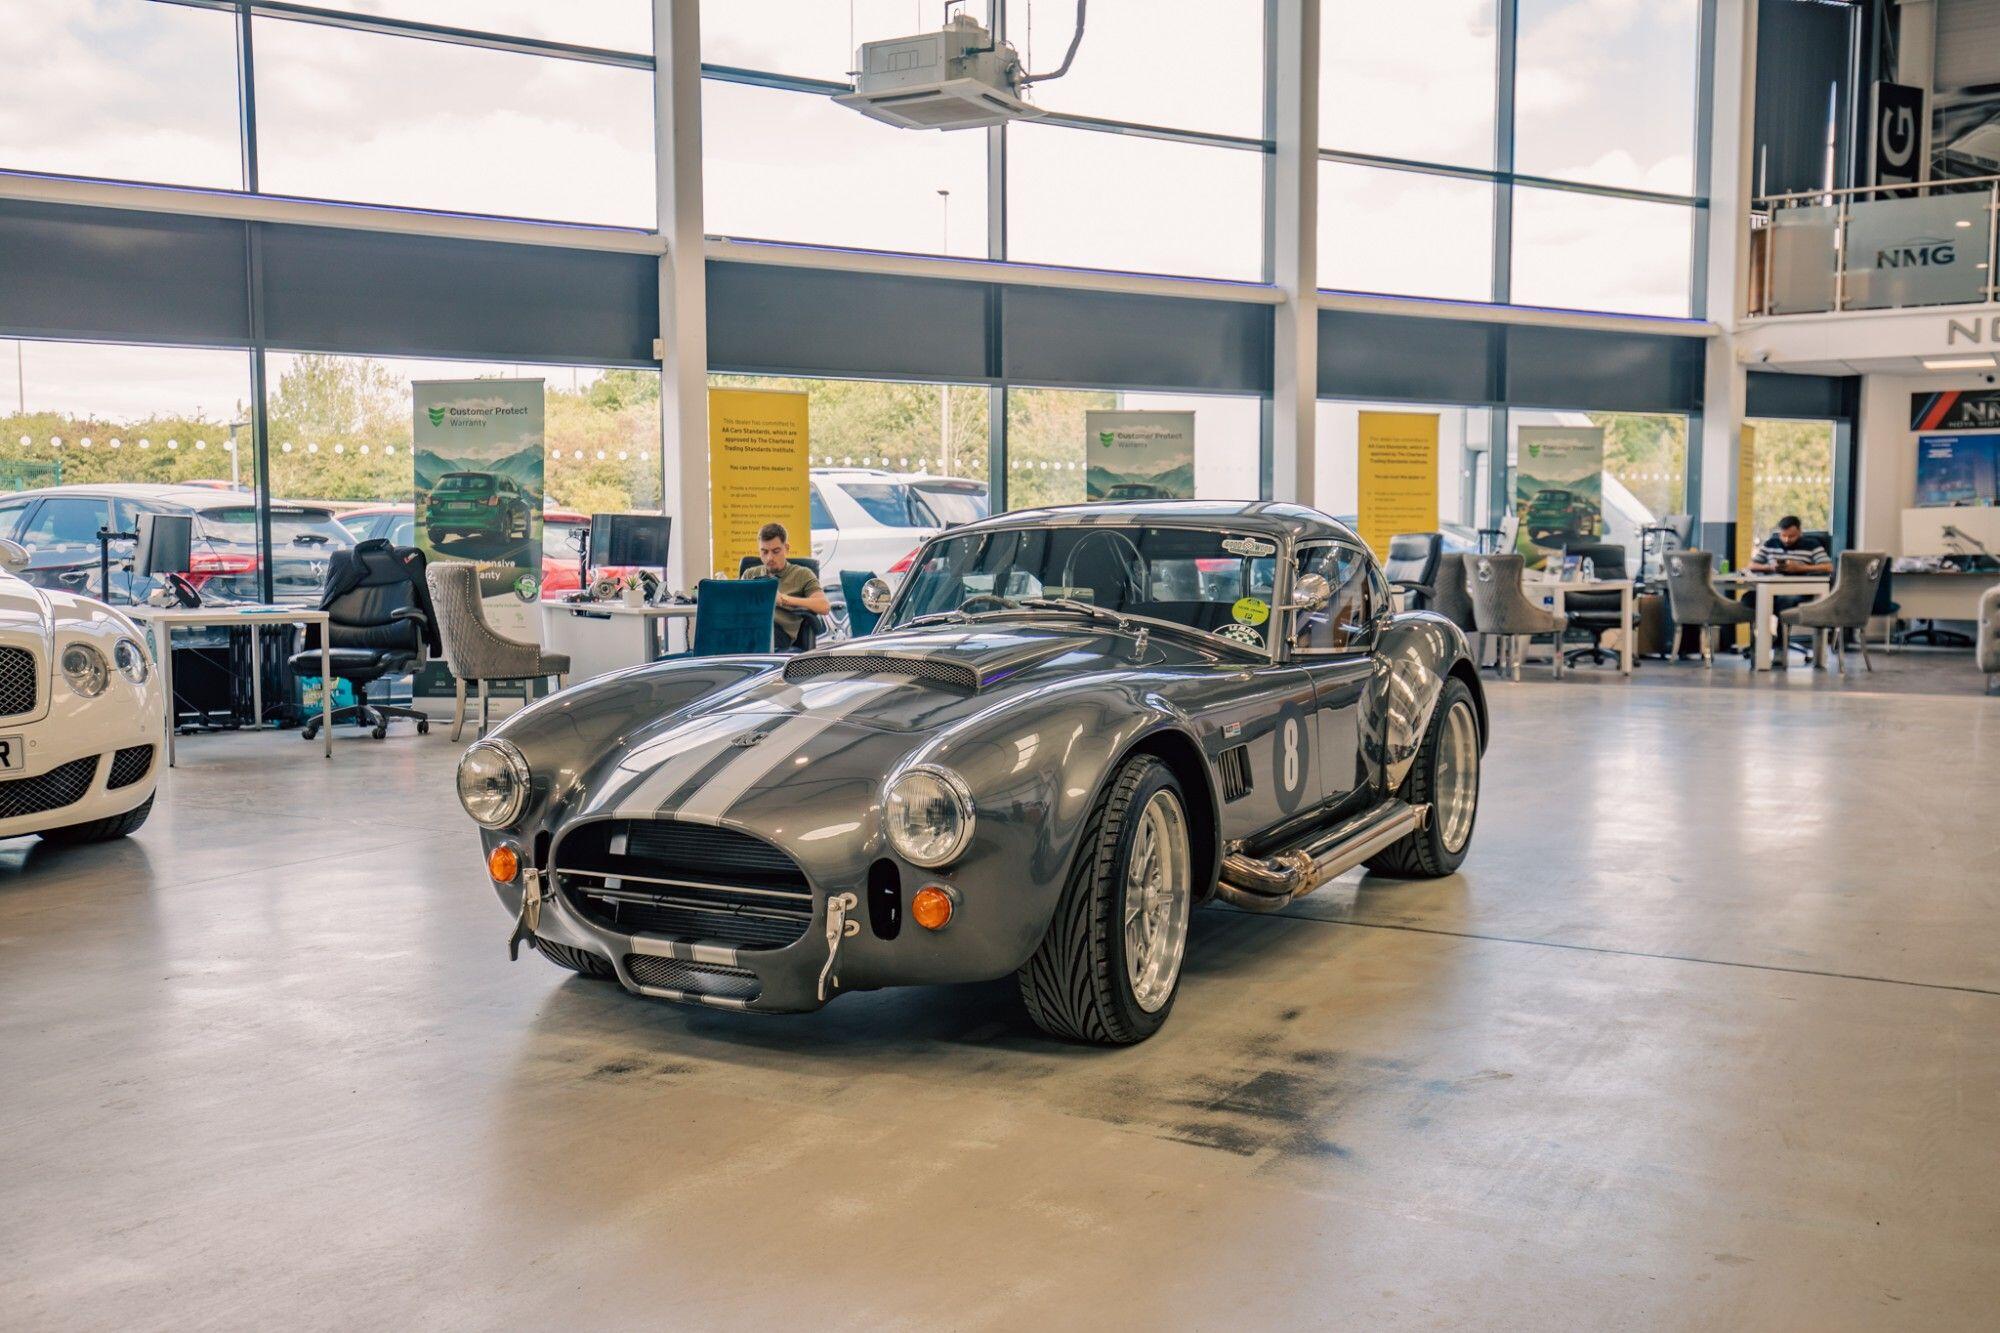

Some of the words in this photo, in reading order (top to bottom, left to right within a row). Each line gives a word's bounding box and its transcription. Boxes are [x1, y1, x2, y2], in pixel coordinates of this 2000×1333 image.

[1876, 245, 1955, 268] NMG
[450, 407, 492, 416] Customer
[495, 406, 528, 415] Protect
[450, 419, 487, 428] Warranty
[1117, 432, 1153, 440] Customer
[1154, 432, 1183, 440] Protect
[724, 445, 744, 453] Trading
[744, 445, 771, 453] Standards
[1283, 718, 1299, 792] 8
